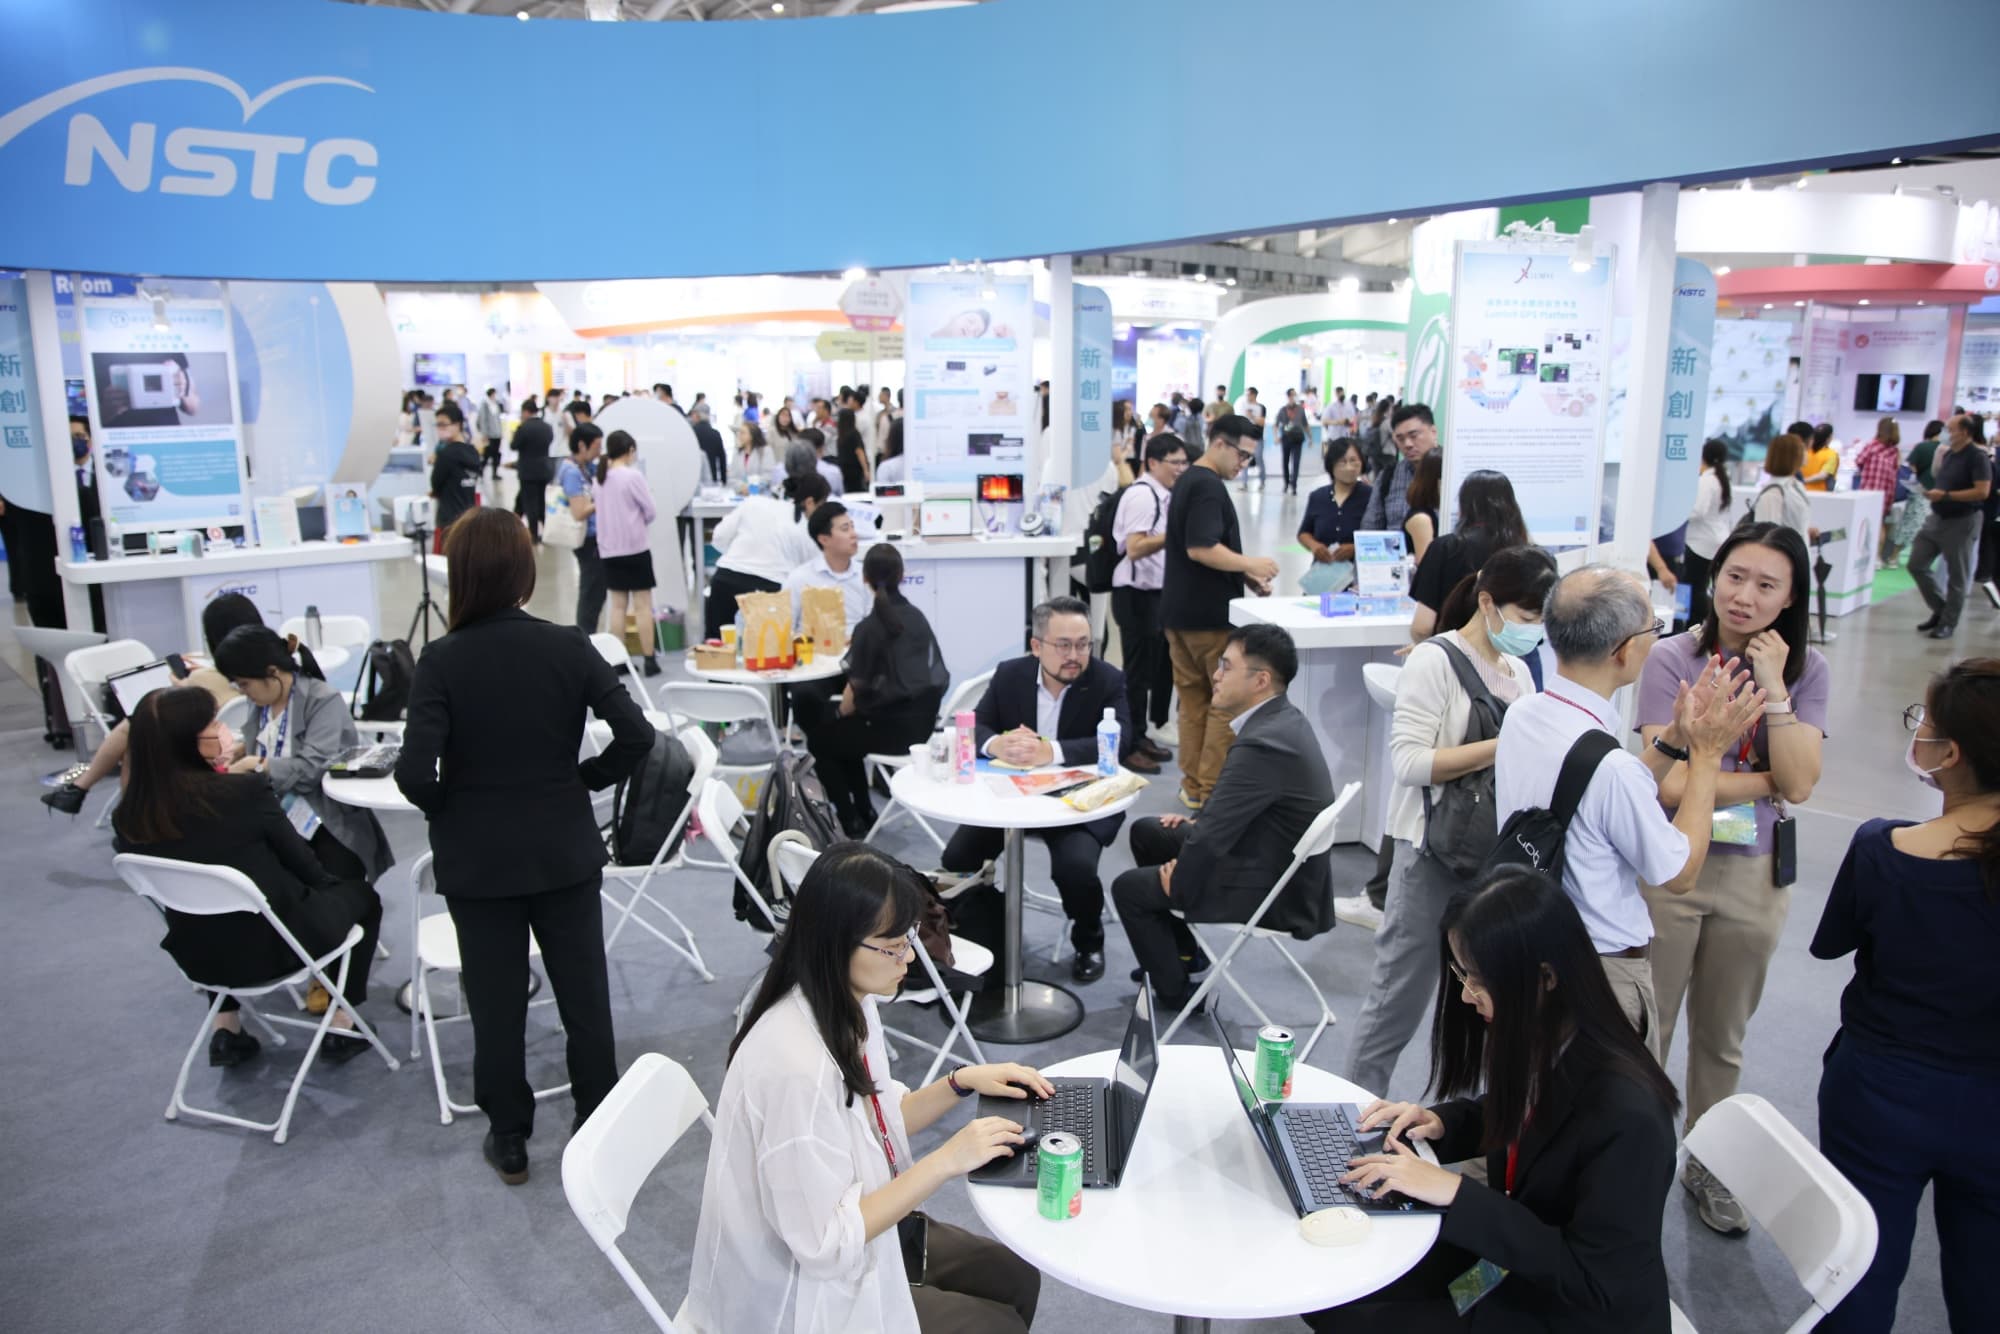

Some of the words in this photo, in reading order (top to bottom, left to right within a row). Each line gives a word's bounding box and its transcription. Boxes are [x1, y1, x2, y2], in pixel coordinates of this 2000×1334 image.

[64, 113, 379, 205] NSTC
[56, 275, 113, 294] Rom
[1679, 288, 1706, 297] NSTC
[1080, 347, 1101, 431] 新創區
[1665, 346, 1698, 461] 新創區
